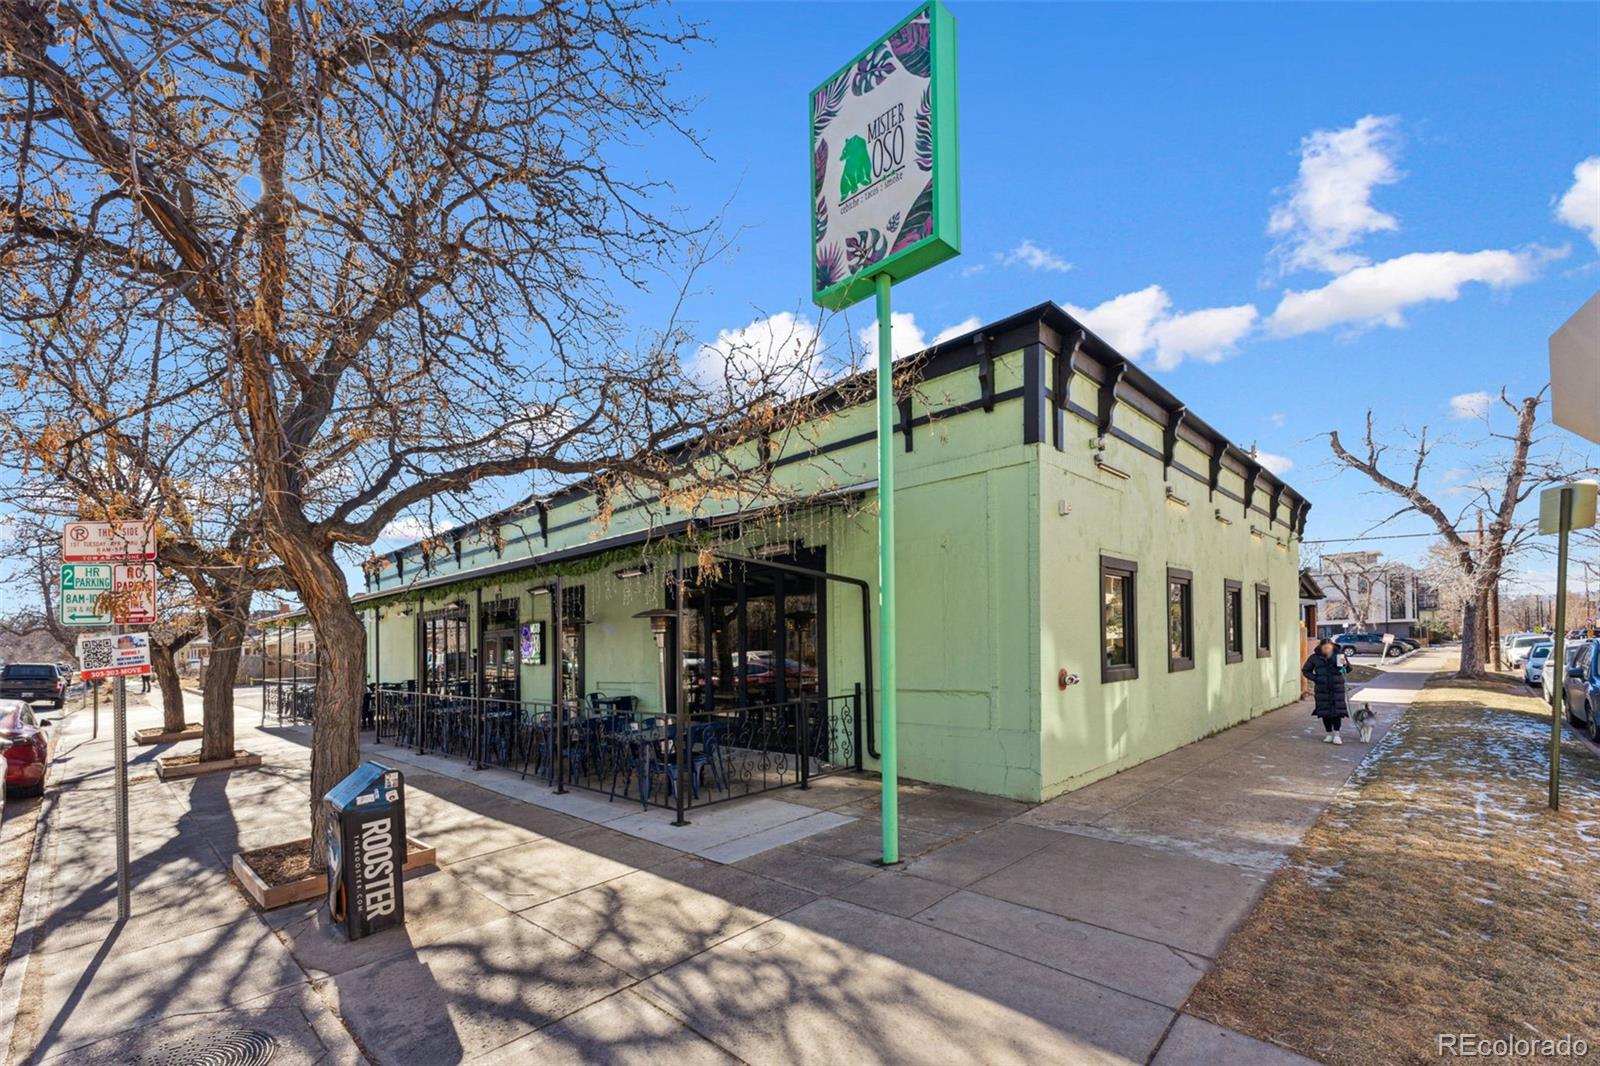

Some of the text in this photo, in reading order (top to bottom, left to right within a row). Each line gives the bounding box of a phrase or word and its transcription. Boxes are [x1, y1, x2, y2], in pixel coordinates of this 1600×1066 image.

[867, 102, 905, 144] MISTER
[872, 125, 905, 178] OSO
[864, 186, 879, 201] tacos
[884, 172, 903, 189] smoke
[98, 527, 139, 537] THI SIDE
[63, 569, 74, 586] 2
[75, 577, 110, 588] PARKING
[85, 567, 100, 577] HR
[353, 835, 364, 913] THEROOSTER.COM
[361, 817, 396, 921] ROOSTER
